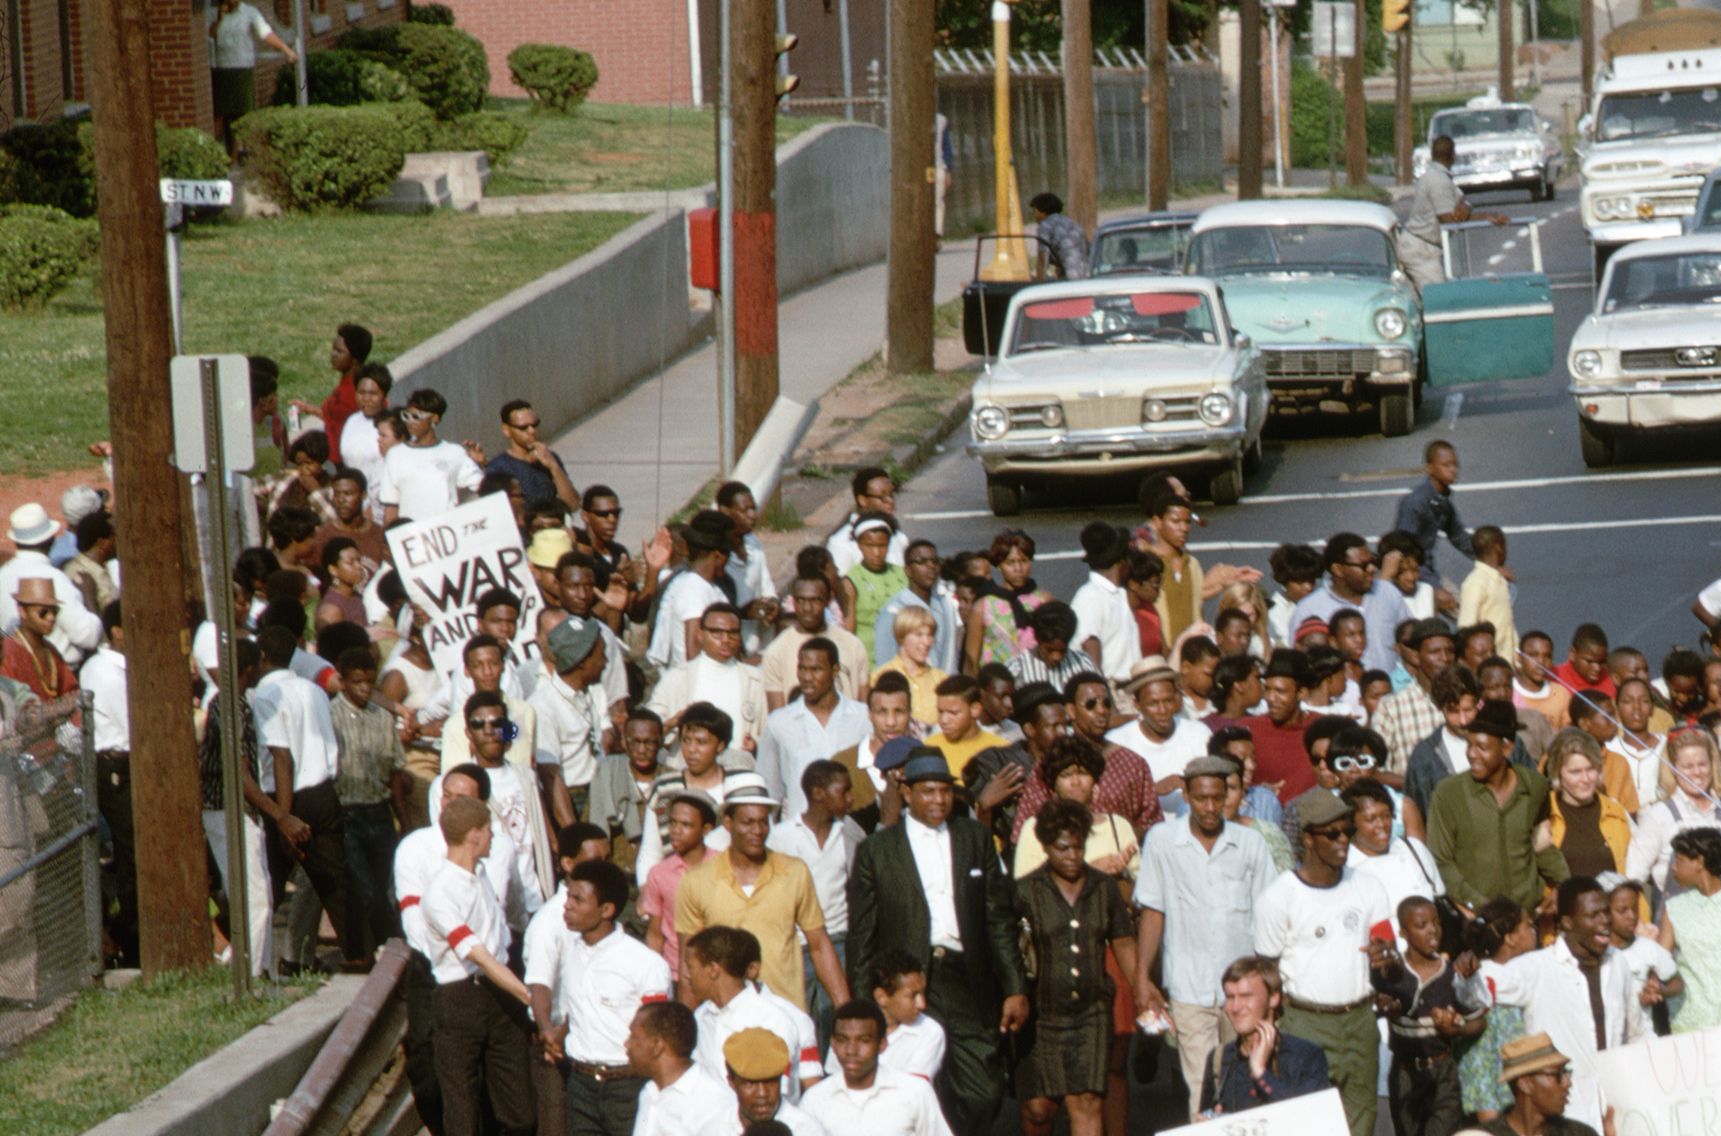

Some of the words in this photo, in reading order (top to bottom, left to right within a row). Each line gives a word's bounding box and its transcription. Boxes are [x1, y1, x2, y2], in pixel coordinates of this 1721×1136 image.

[166, 183, 188, 200] ST
[401, 525, 458, 569] END
[462, 517, 488, 536] THE
[413, 547, 525, 613] WAR
[432, 613, 480, 651] AND
